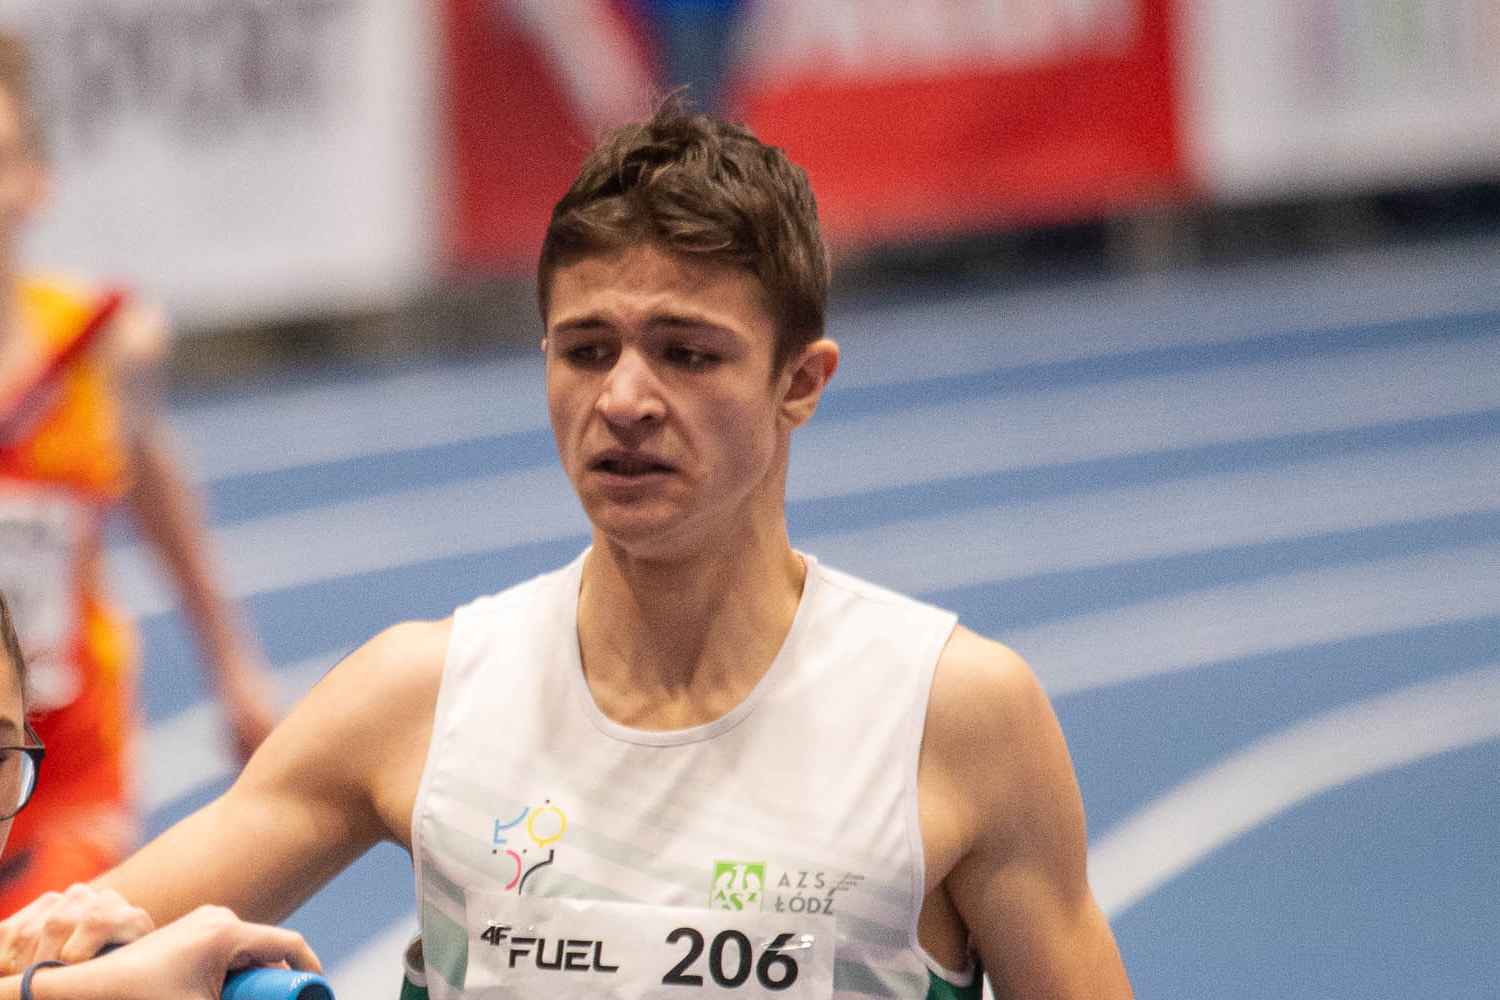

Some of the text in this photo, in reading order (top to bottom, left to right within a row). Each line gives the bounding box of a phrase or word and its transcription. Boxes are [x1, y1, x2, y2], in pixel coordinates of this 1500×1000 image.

[777, 870, 826, 889] AZS
[508, 936, 620, 974] FUEL
[661, 926, 799, 992] 206
